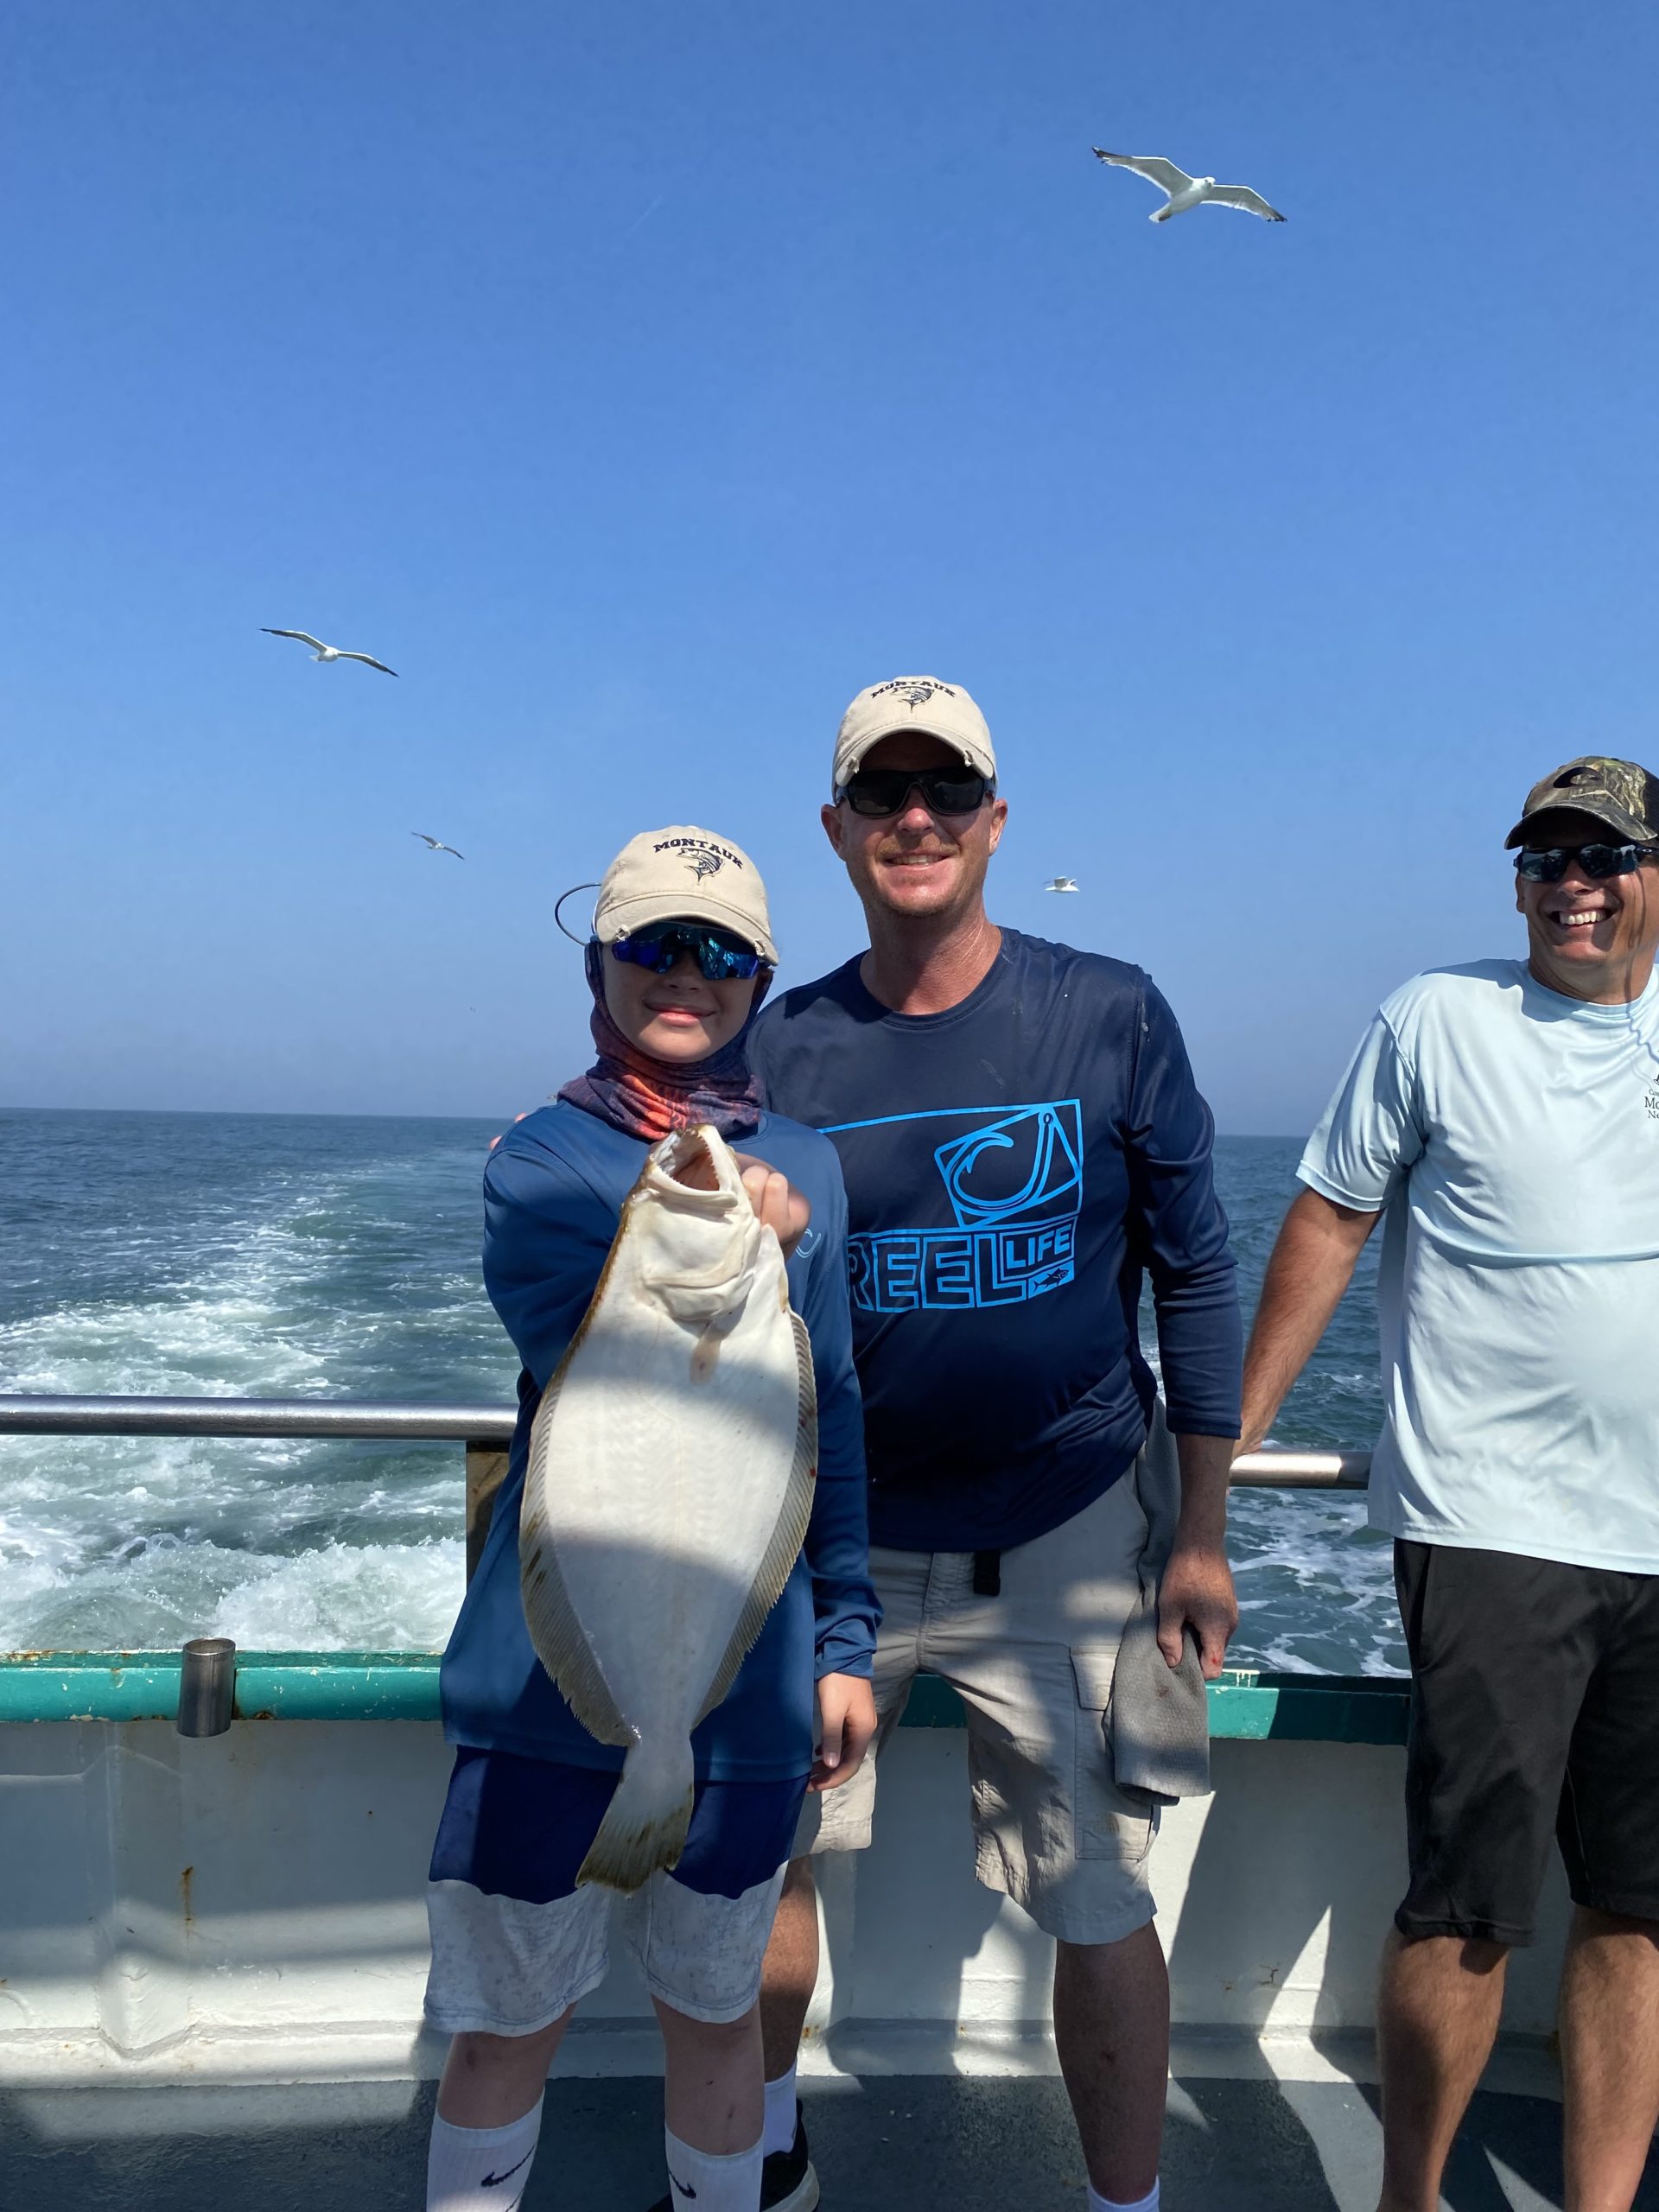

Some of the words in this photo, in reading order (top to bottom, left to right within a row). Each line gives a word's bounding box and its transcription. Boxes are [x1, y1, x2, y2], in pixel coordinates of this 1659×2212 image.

[871, 681, 956, 699] MONTAUK
[652, 838, 744, 869] MONTAUK
[848, 1233, 1027, 1313] REEL
[1006, 1224, 1072, 1269] LIFE
